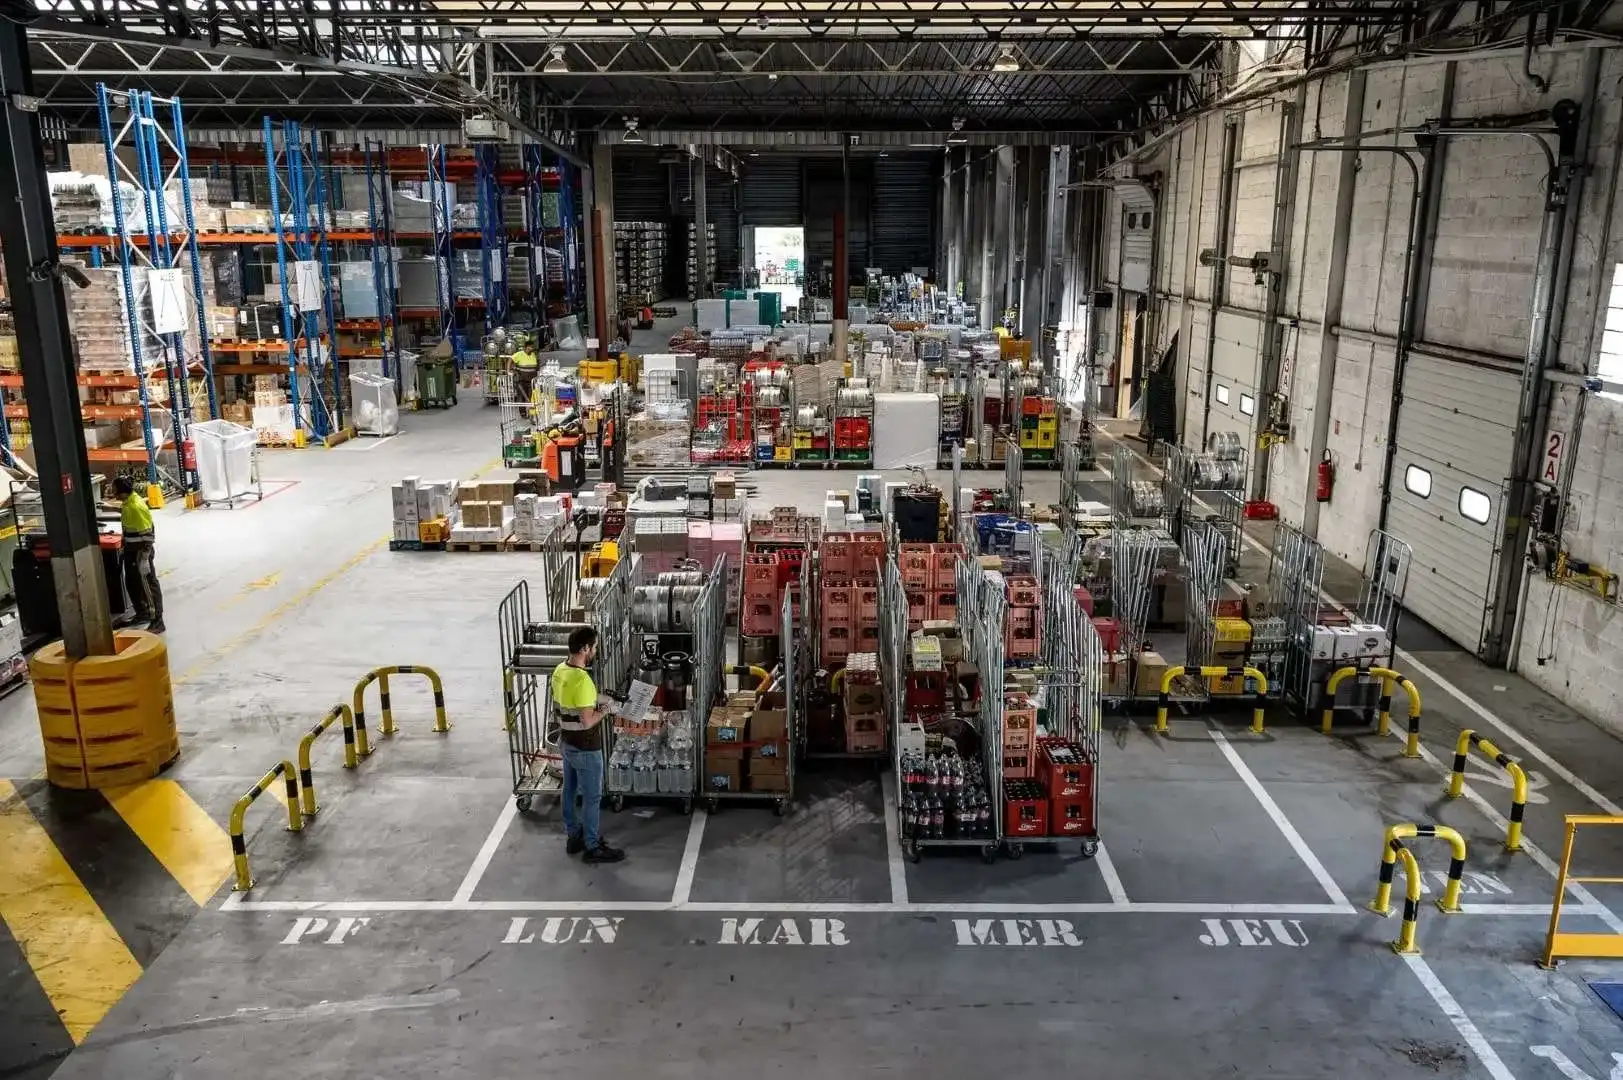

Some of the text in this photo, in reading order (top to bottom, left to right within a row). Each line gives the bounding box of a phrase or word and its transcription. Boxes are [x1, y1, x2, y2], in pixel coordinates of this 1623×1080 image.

[1547, 433, 1561, 458] 2
[1544, 460, 1556, 481] A
[279, 917, 372, 945] PF
[500, 916, 625, 944] LUN
[717, 917, 850, 946] MAR
[951, 919, 1084, 947] MER
[1198, 918, 1310, 947] JEU
